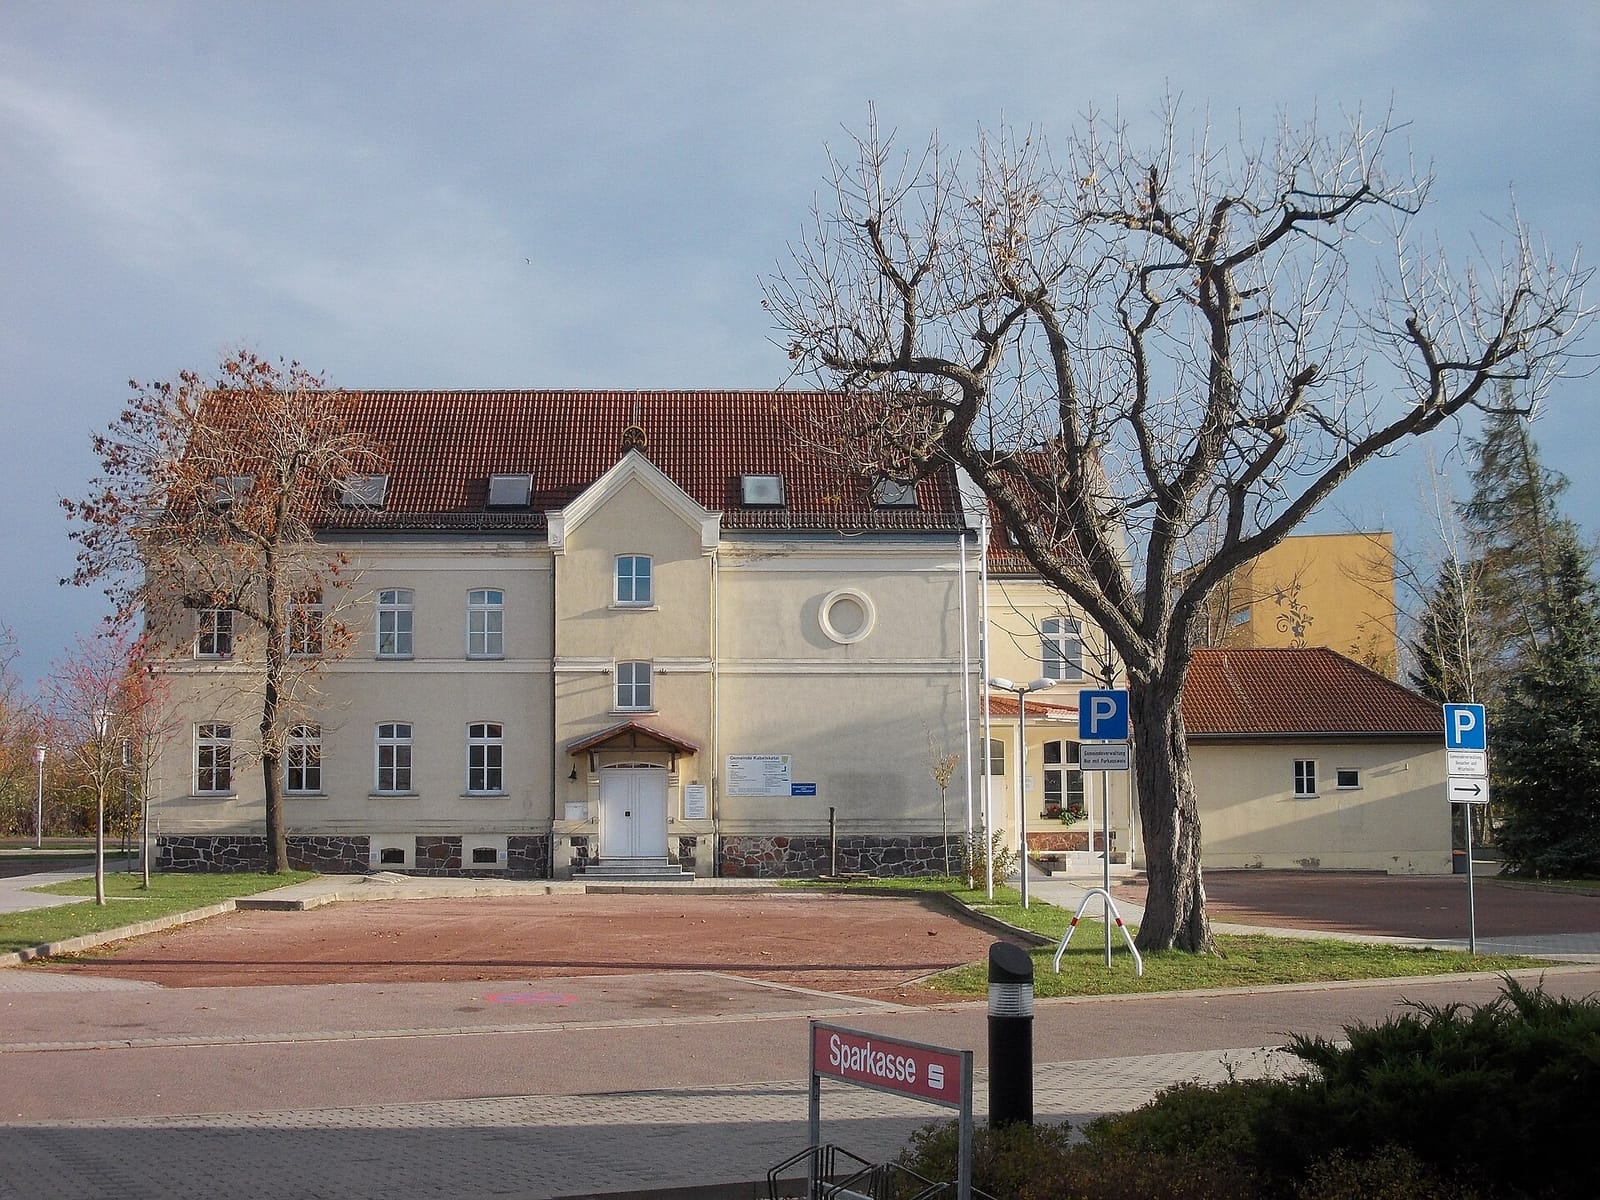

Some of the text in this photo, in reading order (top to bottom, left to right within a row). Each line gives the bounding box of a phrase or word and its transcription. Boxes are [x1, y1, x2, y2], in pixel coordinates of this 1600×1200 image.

[1091, 697, 1117, 734] P
[1454, 709, 1476, 744] P
[829, 1033, 916, 1084] Sparkasse
